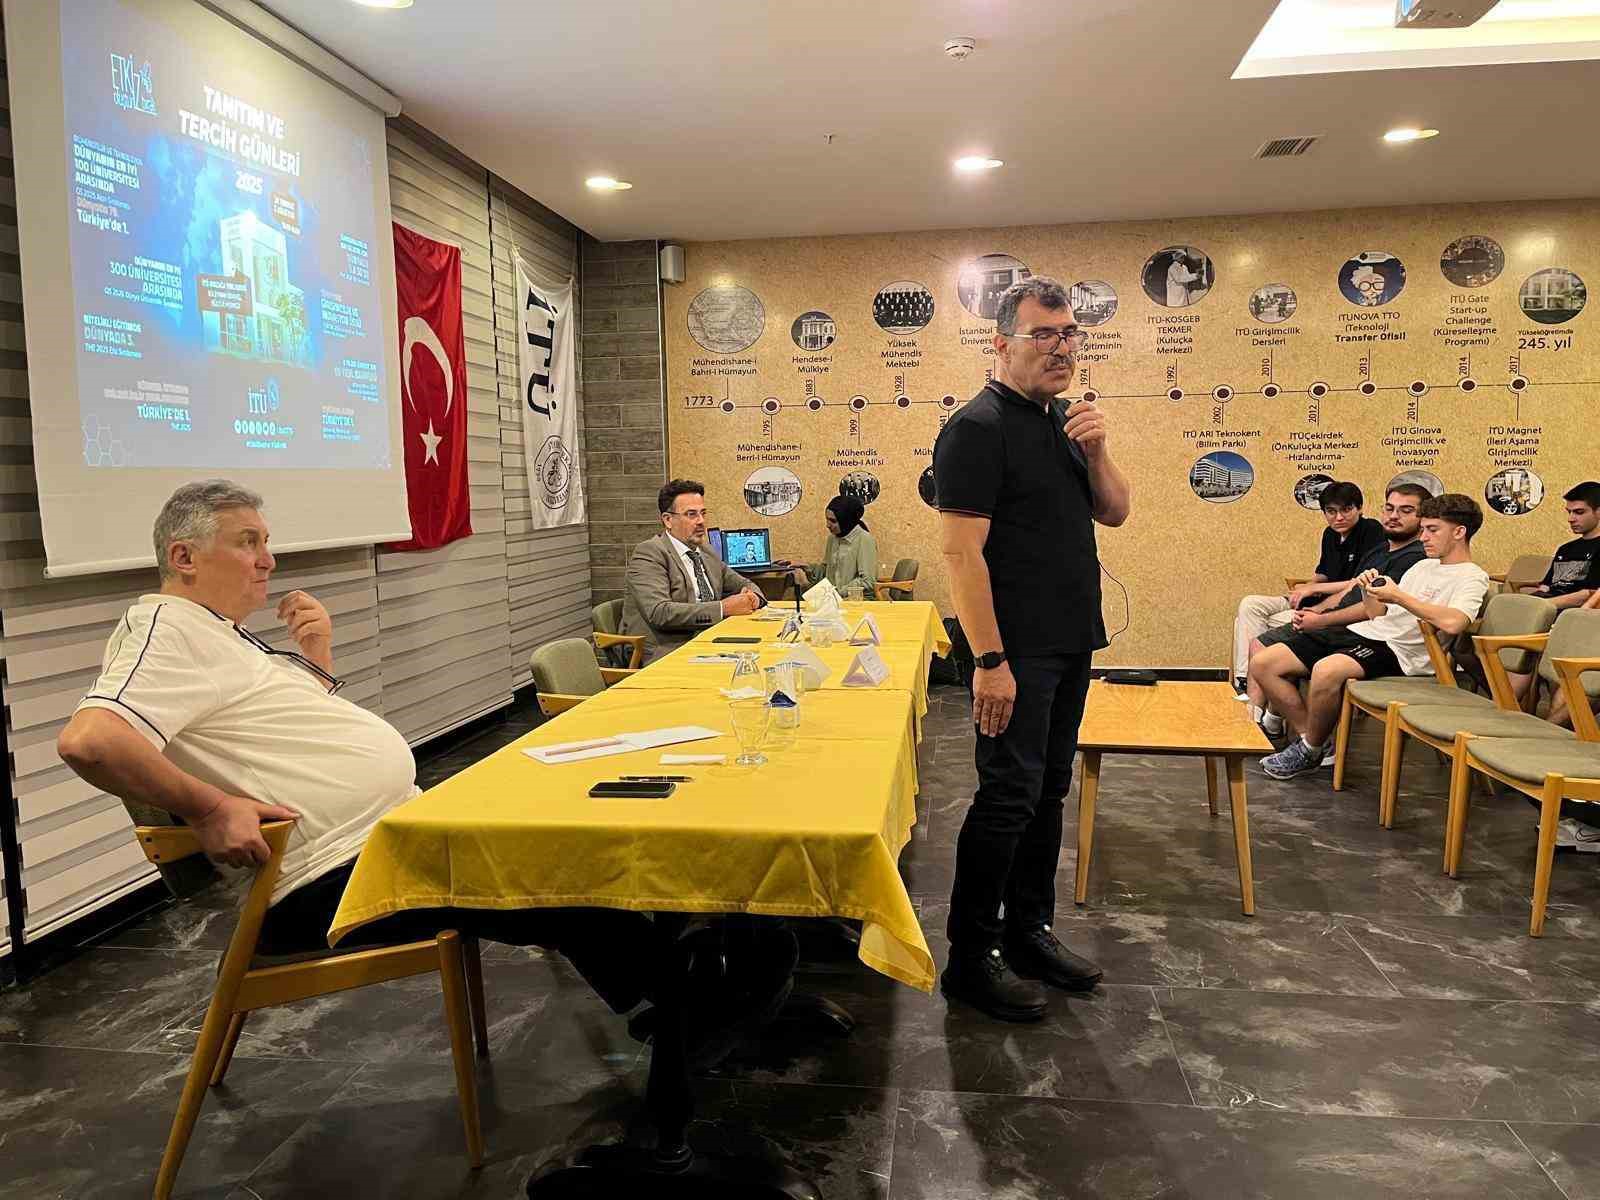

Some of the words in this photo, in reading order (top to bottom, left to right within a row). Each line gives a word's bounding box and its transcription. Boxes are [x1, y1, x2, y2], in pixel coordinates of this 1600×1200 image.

[203, 85, 265, 133] TANITIM
[265, 112, 286, 140] VE
[179, 109, 239, 153] TERCİH
[240, 132, 300, 177] GÜNLERİ
[77, 208, 122, 232] Türkiye'de
[110, 260, 128, 276] 300
[1467, 295, 1490, 303] Gate
[1450, 306, 1488, 315] Start-up
[1382, 311, 1401, 320] TTO
[1445, 316, 1492, 325] Challenge
[1157, 326, 1192, 334] TEKMER
[1251, 327, 1301, 337] Girişimcilik
[1090, 331, 1122, 339] Yüksek
[1335, 334, 1378, 343] Transfer
[887, 340, 917, 348] Yüksek
[1156, 337, 1193, 346] (Kuluçka
[1251, 338, 1286, 346] Dersleri
[1444, 337, 1490, 347] Programı)
[1518, 338, 1550, 350] 245.
[1553, 336, 1571, 351] yıl
[1082, 342, 1122, 352] ğitiminin
[1156, 346, 1193, 354] Merkezi)
[881, 350, 922, 358] Mühendis
[692, 358, 757, 367] Mühendishane-i
[885, 360, 920, 368] Mektebi
[1359, 357, 1368, 376] 2013
[1459, 356, 1468, 375] 2014
[1509, 355, 1518, 374] 2017
[718, 368, 757, 376] Hümayun
[798, 366, 829, 375] Mülkiye
[1261, 358, 1270, 377] 2010
[1080, 368, 1088, 385] 1974
[1166, 365, 1175, 383] 1992
[805, 379, 814, 396] 1883
[894, 375, 902, 393] 1928
[684, 395, 714, 406] 1773
[1213, 406, 1222, 424] 2002
[1308, 404, 1318, 424] 2012
[1407, 402, 1416, 421] 2014
[762, 419, 770, 436] 1795
[849, 419, 857, 436] 1909
[1506, 426, 1542, 436] Magnet
[1215, 429, 1261, 438] Teknokent
[1195, 440, 1221, 449] (Bilim
[1222, 439, 1247, 449] Parkı)
[1381, 437, 1434, 446] (Girişimcilik
[1508, 437, 1540, 446] Aşama
[737, 443, 802, 452] Mühendishane-i
[1271, 442, 1322, 452] (ÖnKuluçka
[1323, 441, 1360, 449] Merkezi
[836, 448, 878, 457] Mühendis
[1285, 453, 1345, 461] -Hızlandırma-
[1487, 448, 1538, 457] Girişimcilik
[736, 454, 760, 462] Berri-i
[761, 454, 801, 463] Hümayun
[827, 459, 864, 467] Mekteb-i
[1395, 458, 1434, 466] Merkezi)
[1494, 458, 1533, 466] Merkezi)
[1297, 463, 1335, 472] Kuluçka)
